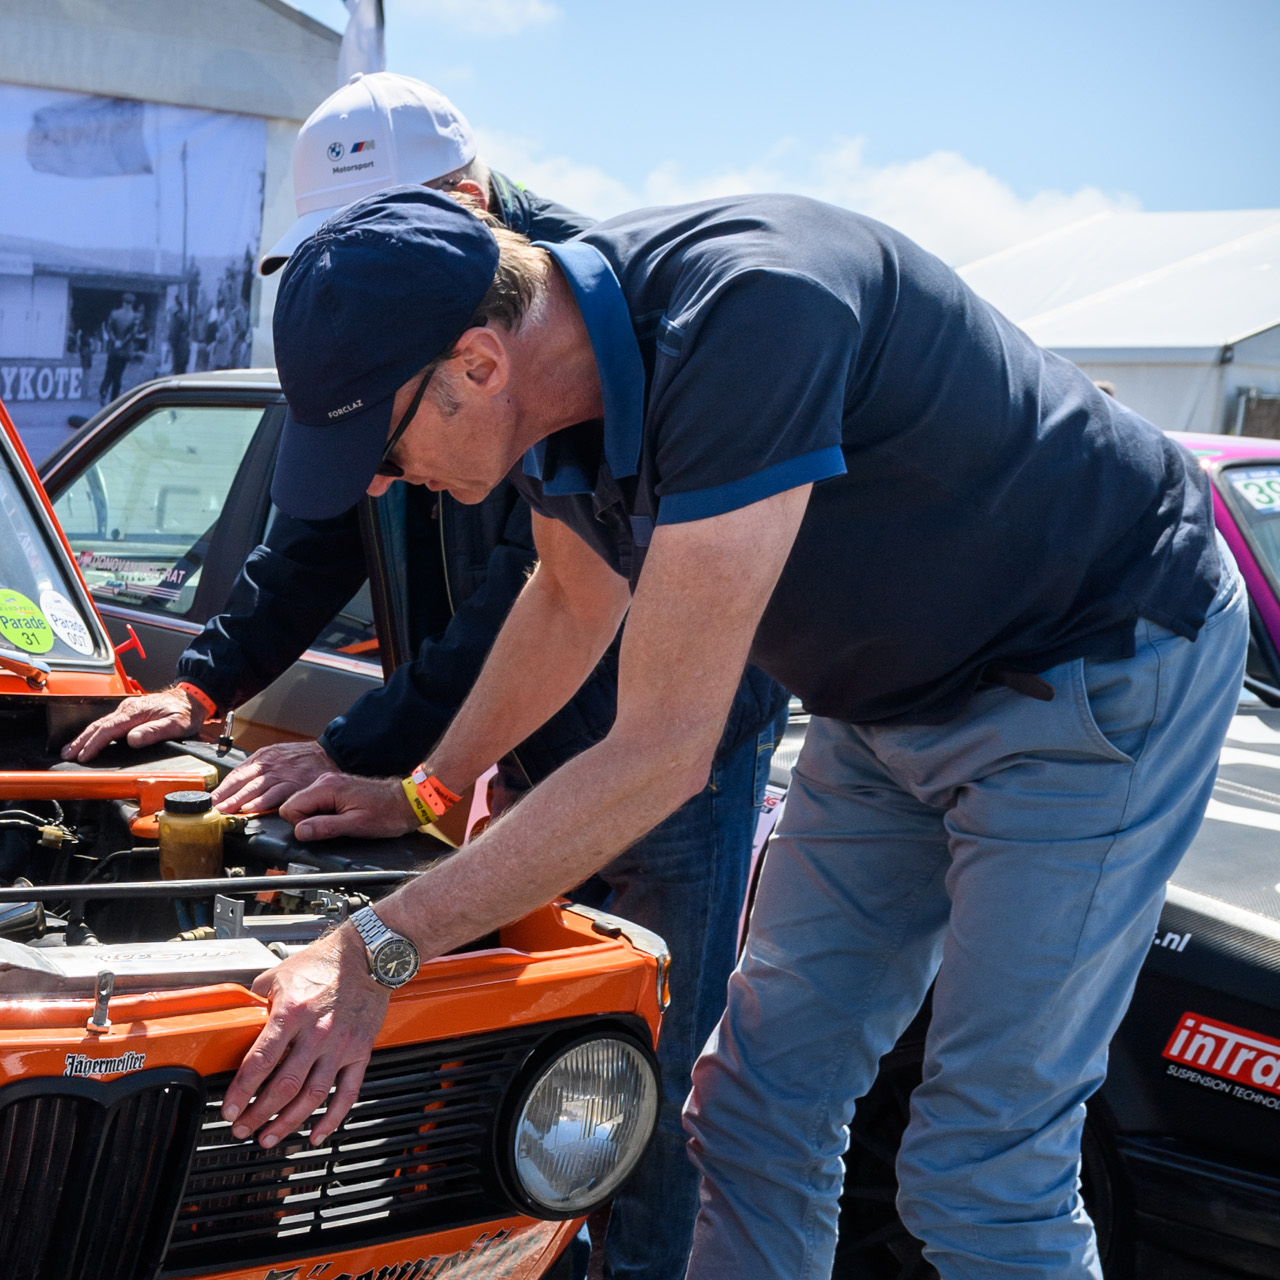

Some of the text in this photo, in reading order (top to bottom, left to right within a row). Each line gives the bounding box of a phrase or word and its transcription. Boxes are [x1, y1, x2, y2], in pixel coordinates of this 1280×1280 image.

[332, 160, 375, 174] Motorsport
[327, 399, 364, 419] FORCLAZ
[0, 614, 46, 630] Parade
[50, 613, 87, 635] Parade
[21, 631, 41, 646] 31
[1153, 930, 1192, 952] .nl
[63, 1050, 146, 1078] Jägermeister
[1169, 1018, 1280, 1091] inTra
[1166, 1064, 1232, 1093] SUSPENSION
